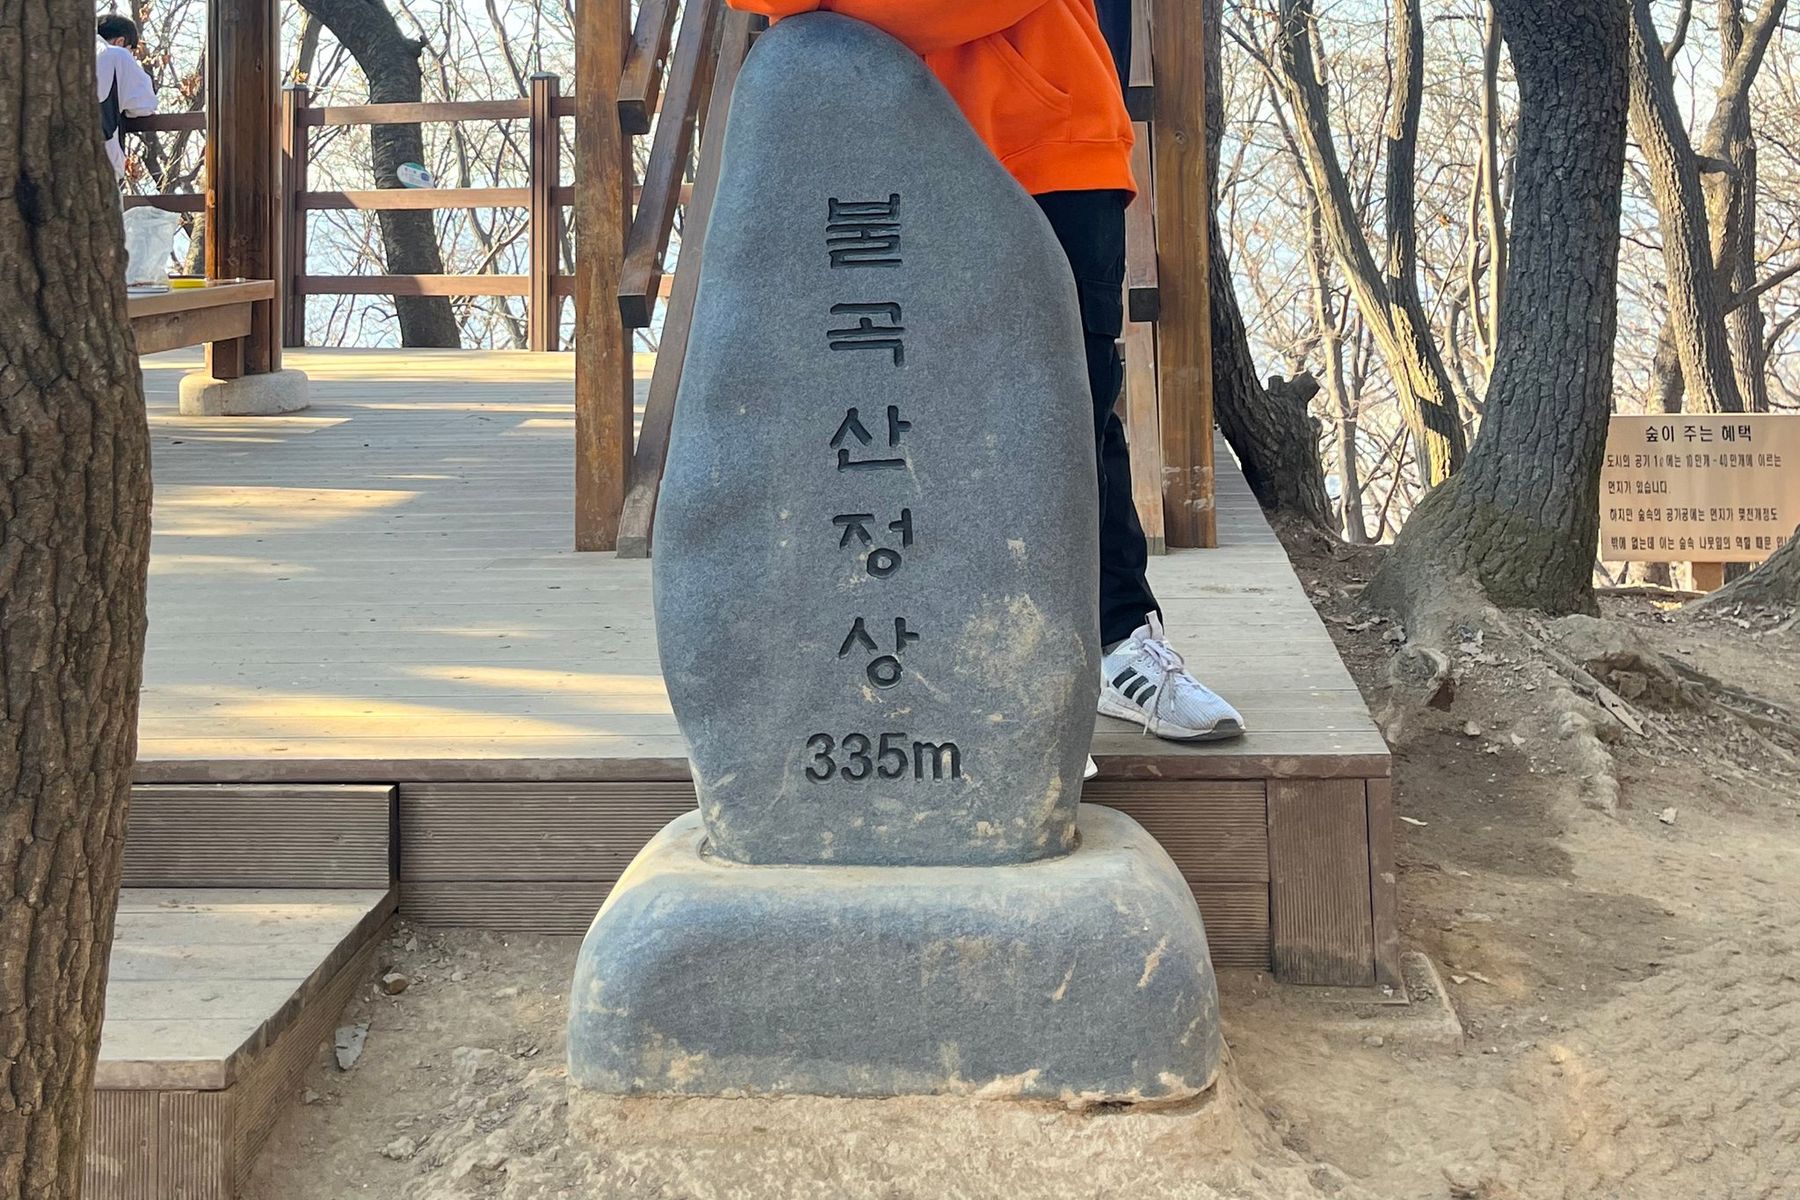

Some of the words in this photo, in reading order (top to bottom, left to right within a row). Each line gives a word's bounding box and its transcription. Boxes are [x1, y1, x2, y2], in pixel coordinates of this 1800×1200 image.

[1645, 425, 1675, 443] 숲이
[1683, 425, 1713, 443] 주는
[1721, 425, 1752, 443] 혜택
[1607, 454, 1631, 468] 도시의
[1635, 454, 1650, 468] 공기
[1758, 453, 1782, 468] 이르는
[1608, 480, 1631, 495] 먼지가
[1609, 507, 1633, 522] 하지만
[1638, 507, 1661, 522] 숲속의
[1710, 507, 1733, 521] 먼지가
[1659, 536, 1675, 550] 이는
[805, 732, 962, 785] 335m
